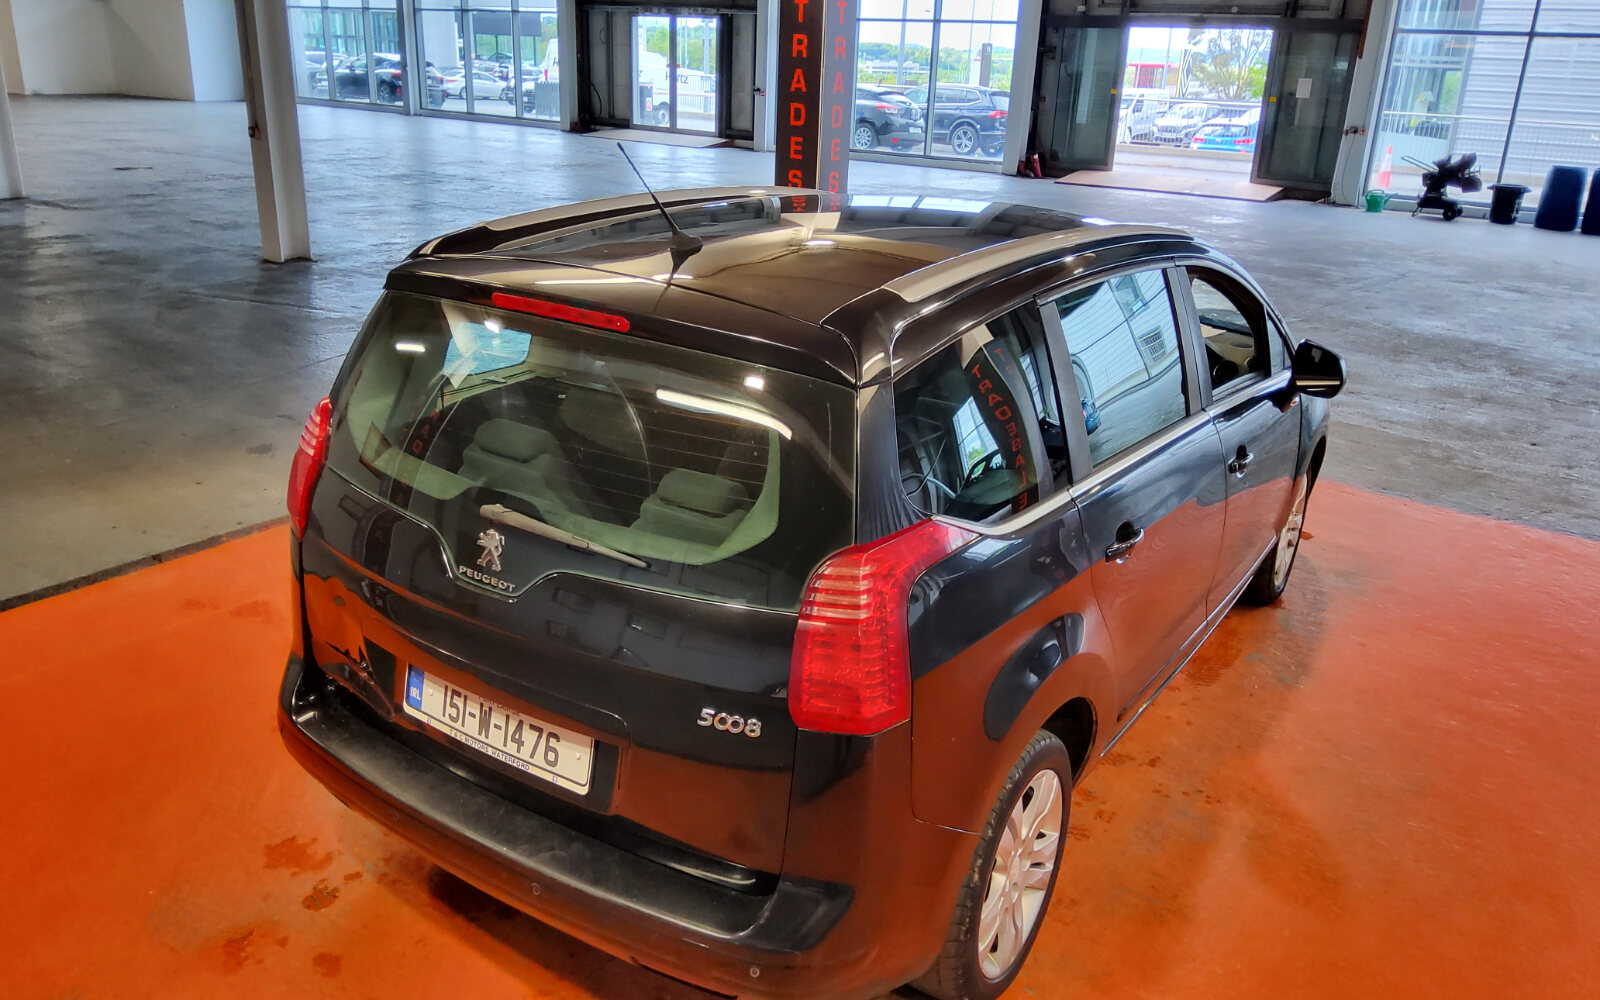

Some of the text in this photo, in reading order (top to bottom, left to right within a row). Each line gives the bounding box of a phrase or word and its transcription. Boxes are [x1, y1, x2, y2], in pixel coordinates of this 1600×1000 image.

[458, 565, 516, 592] PEUGEOT
[410, 686, 421, 700] IRL
[442, 684, 561, 768] 151-W-1476
[696, 707, 762, 738] 5008
[464, 736, 489, 753] MOTORS
[491, 748, 530, 771] WATERFORD
